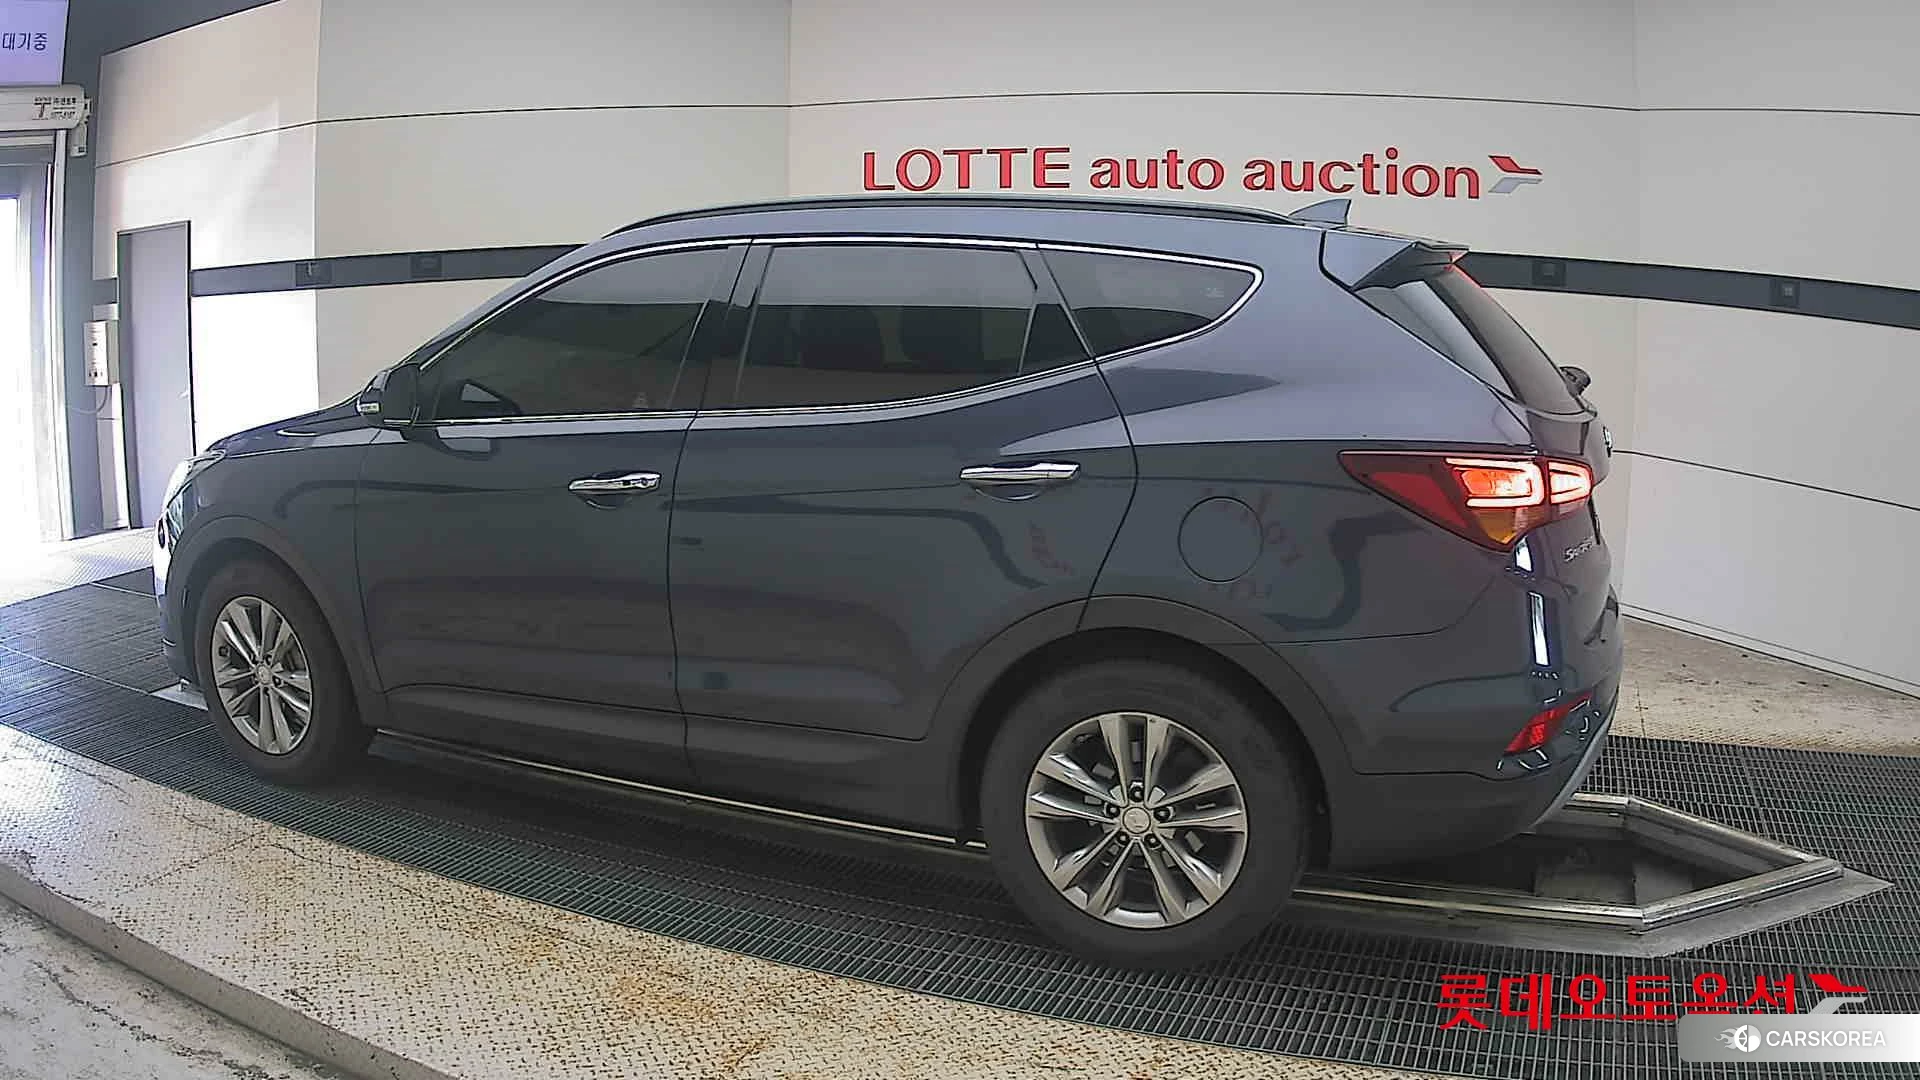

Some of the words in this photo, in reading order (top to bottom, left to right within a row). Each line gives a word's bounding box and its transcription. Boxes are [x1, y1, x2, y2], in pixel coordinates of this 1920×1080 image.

[2, 32, 49, 51] 대기중
[863, 147, 1070, 192] LOTTE
[1089, 149, 1226, 191] auto
[1242, 147, 1481, 199] auction
